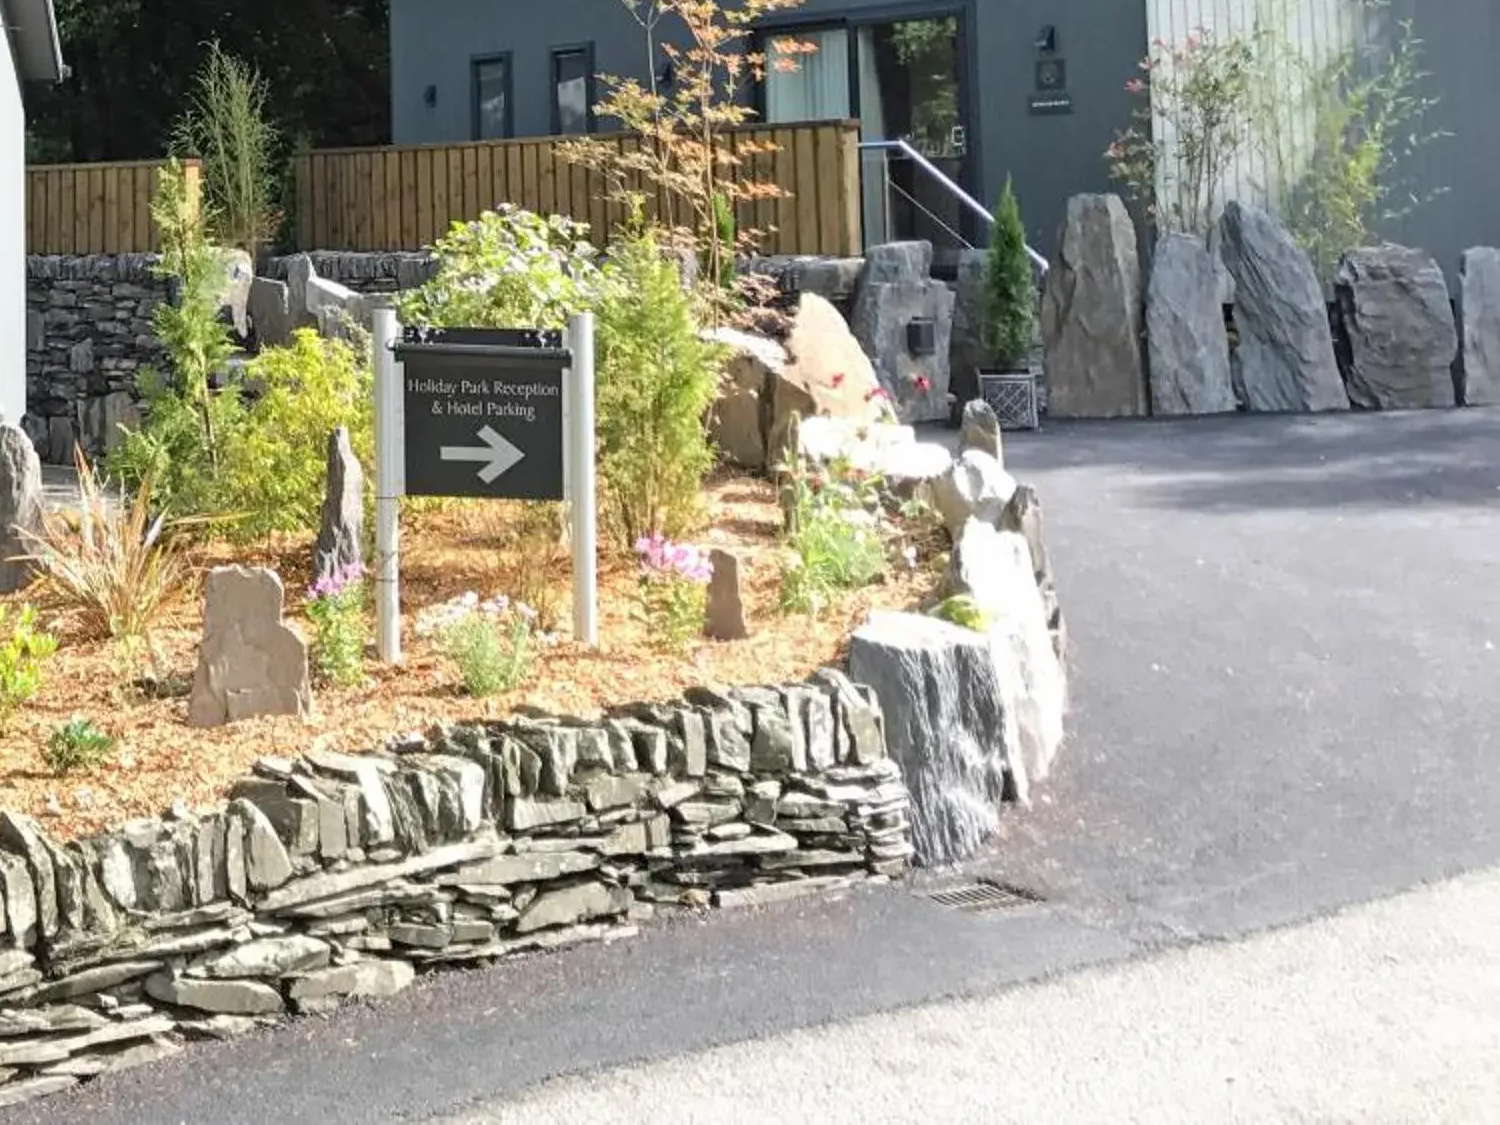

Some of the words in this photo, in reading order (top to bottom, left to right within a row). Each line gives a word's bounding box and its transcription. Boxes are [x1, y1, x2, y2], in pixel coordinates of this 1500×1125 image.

[407, 378, 457, 397] Holiday
[461, 379, 490, 395] Park
[493, 380, 559, 401] Reception
[431, 400, 443, 415] &
[447, 400, 483, 416] Hotel
[487, 401, 536, 422] Parking
